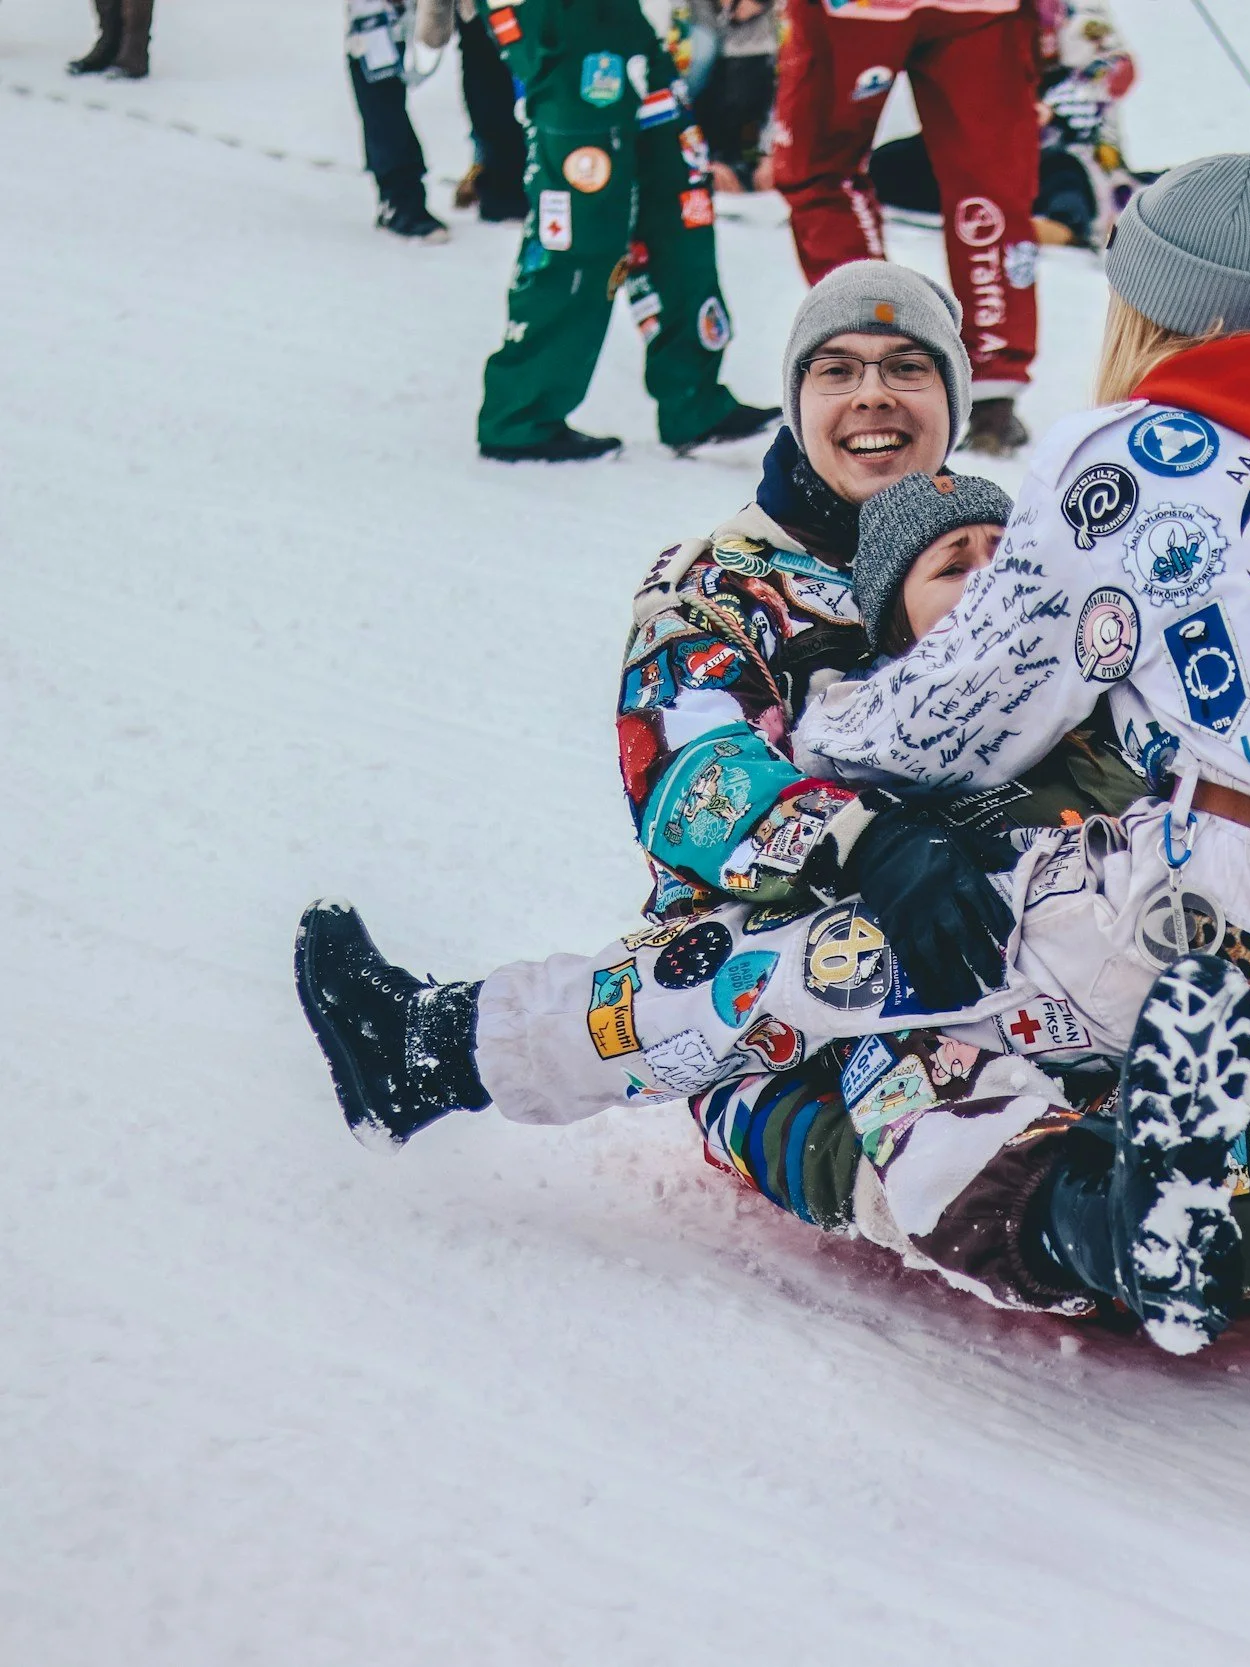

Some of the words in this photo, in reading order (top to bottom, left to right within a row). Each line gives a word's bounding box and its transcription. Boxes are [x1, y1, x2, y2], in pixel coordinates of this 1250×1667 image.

[1068, 470, 1120, 508] TIETOKILTA
[1092, 504, 1131, 532] OTANIEMI
[1130, 510, 1194, 551] AALTO-YLIOPISTON
[1152, 543, 1202, 583] SIK
[871, 979, 885, 995] 18
[614, 1004, 635, 1049] Kvantti
[1042, 1002, 1062, 1044] FIKSU
